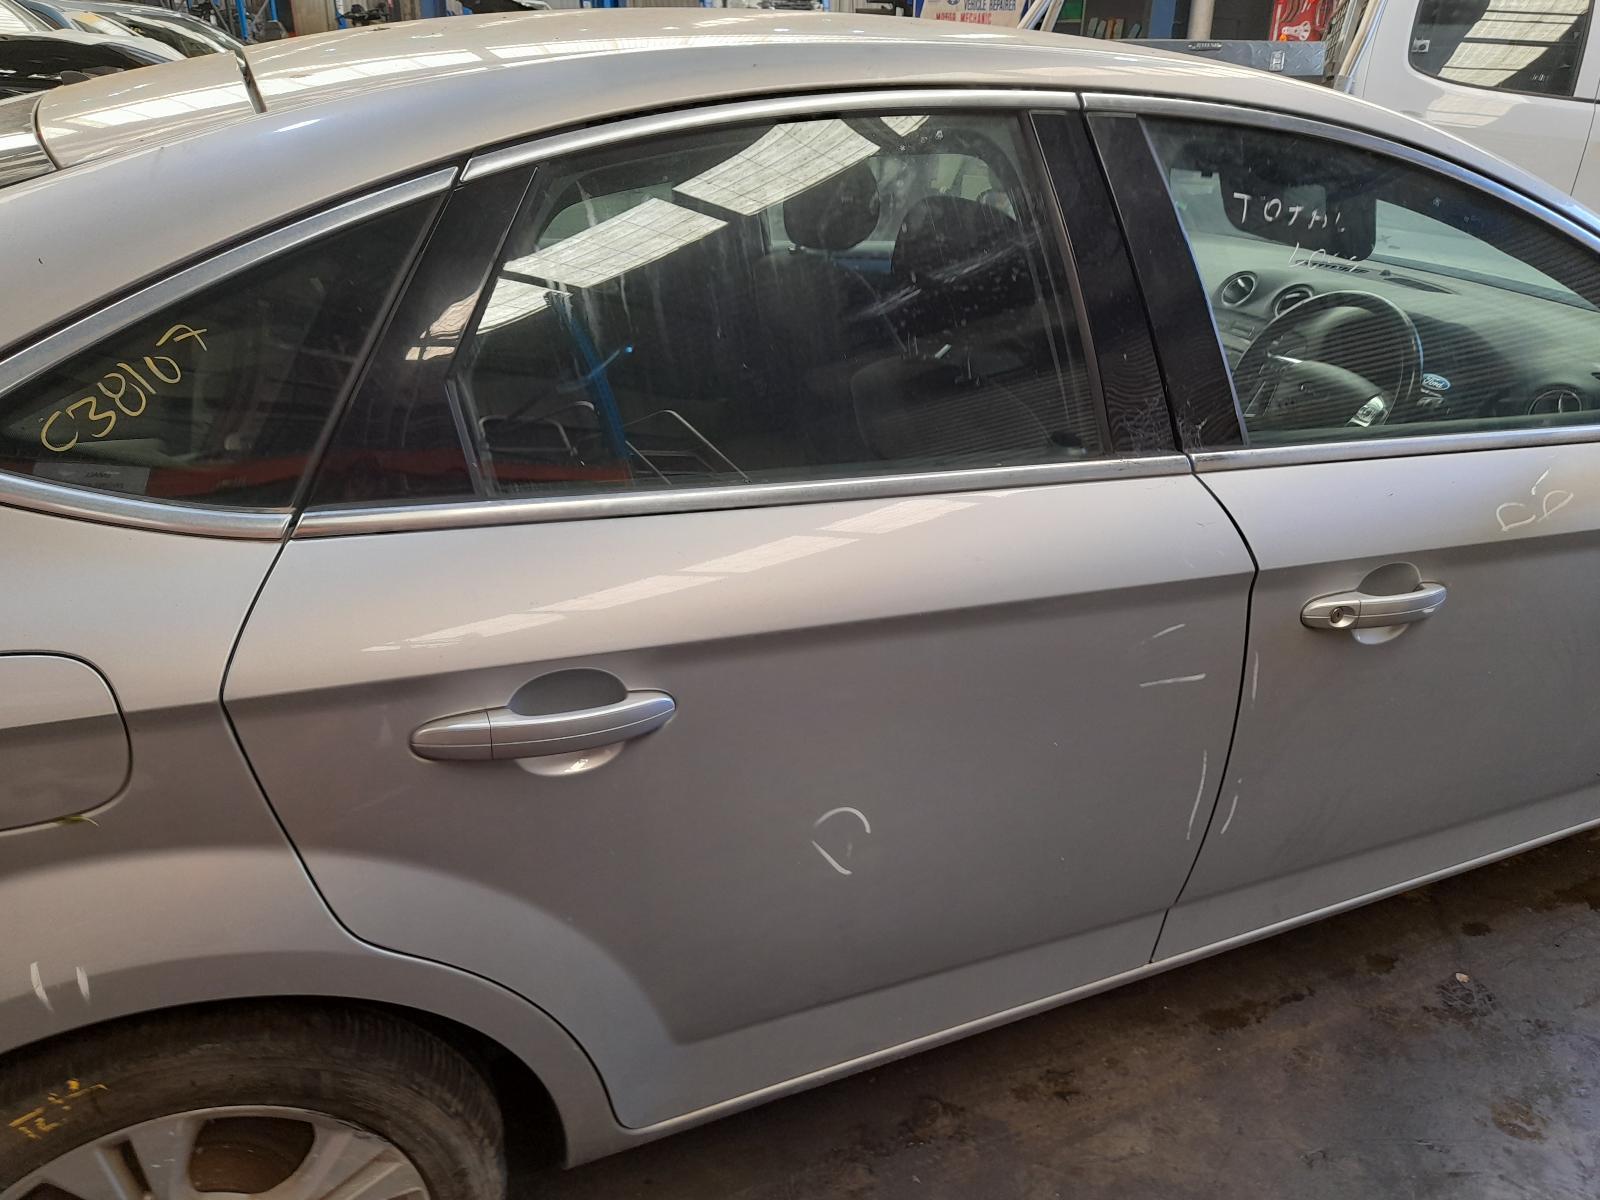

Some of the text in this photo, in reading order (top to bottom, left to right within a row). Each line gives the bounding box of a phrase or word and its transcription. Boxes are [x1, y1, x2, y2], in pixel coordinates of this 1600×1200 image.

[964, 0, 1016, 11] VEHICLE REPAIRER
[935, 12, 992, 24] MOTOR MECHANIC
[40, 324, 208, 452] C38107
